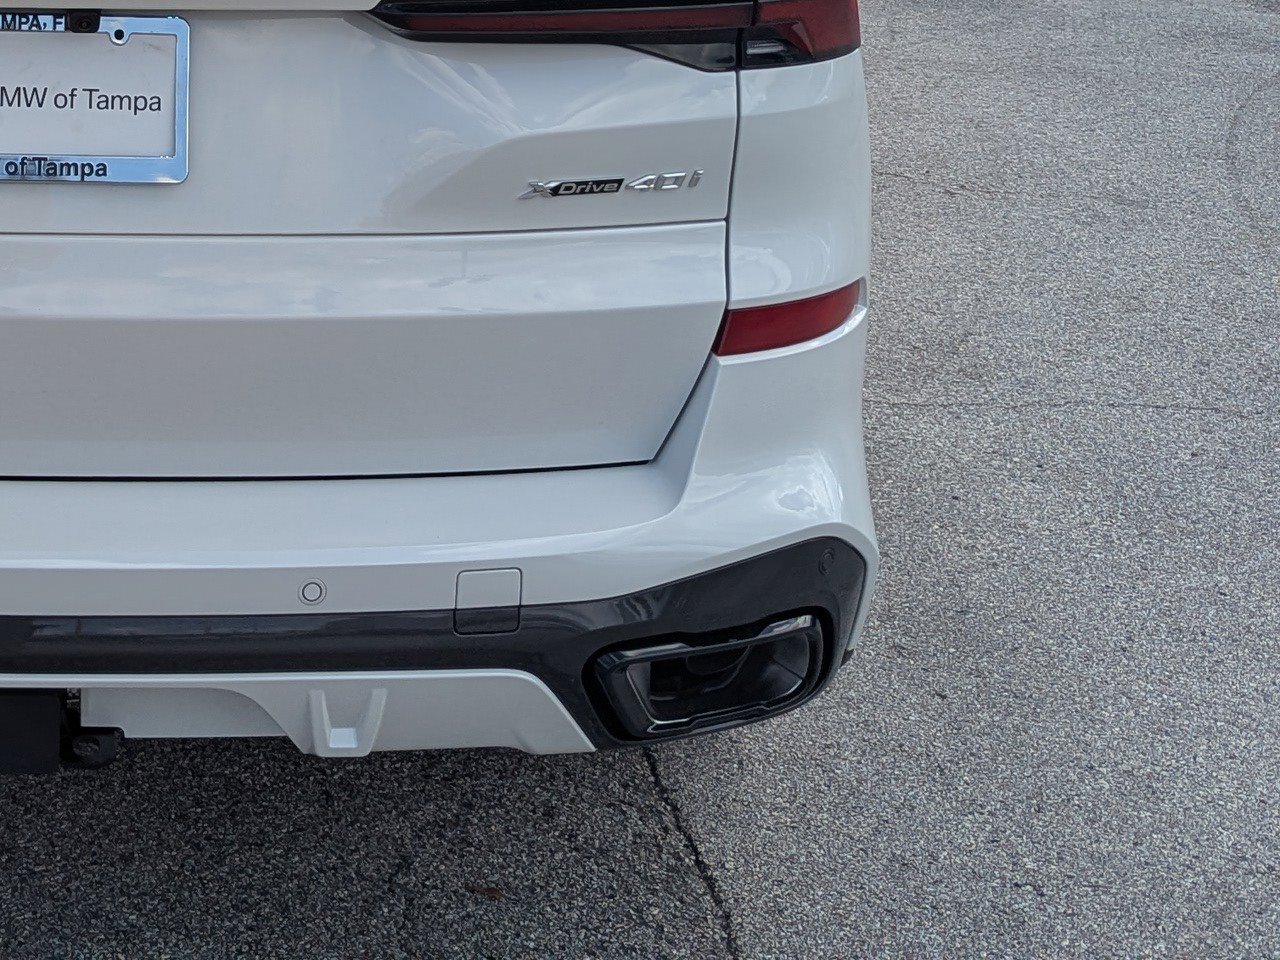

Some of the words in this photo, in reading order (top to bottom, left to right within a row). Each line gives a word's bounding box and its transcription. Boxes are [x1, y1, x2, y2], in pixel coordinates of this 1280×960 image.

[53, 88, 78, 109] of
[82, 88, 162, 116] Tampa
[5, 156, 31, 176] of
[32, 157, 108, 182] Tampa
